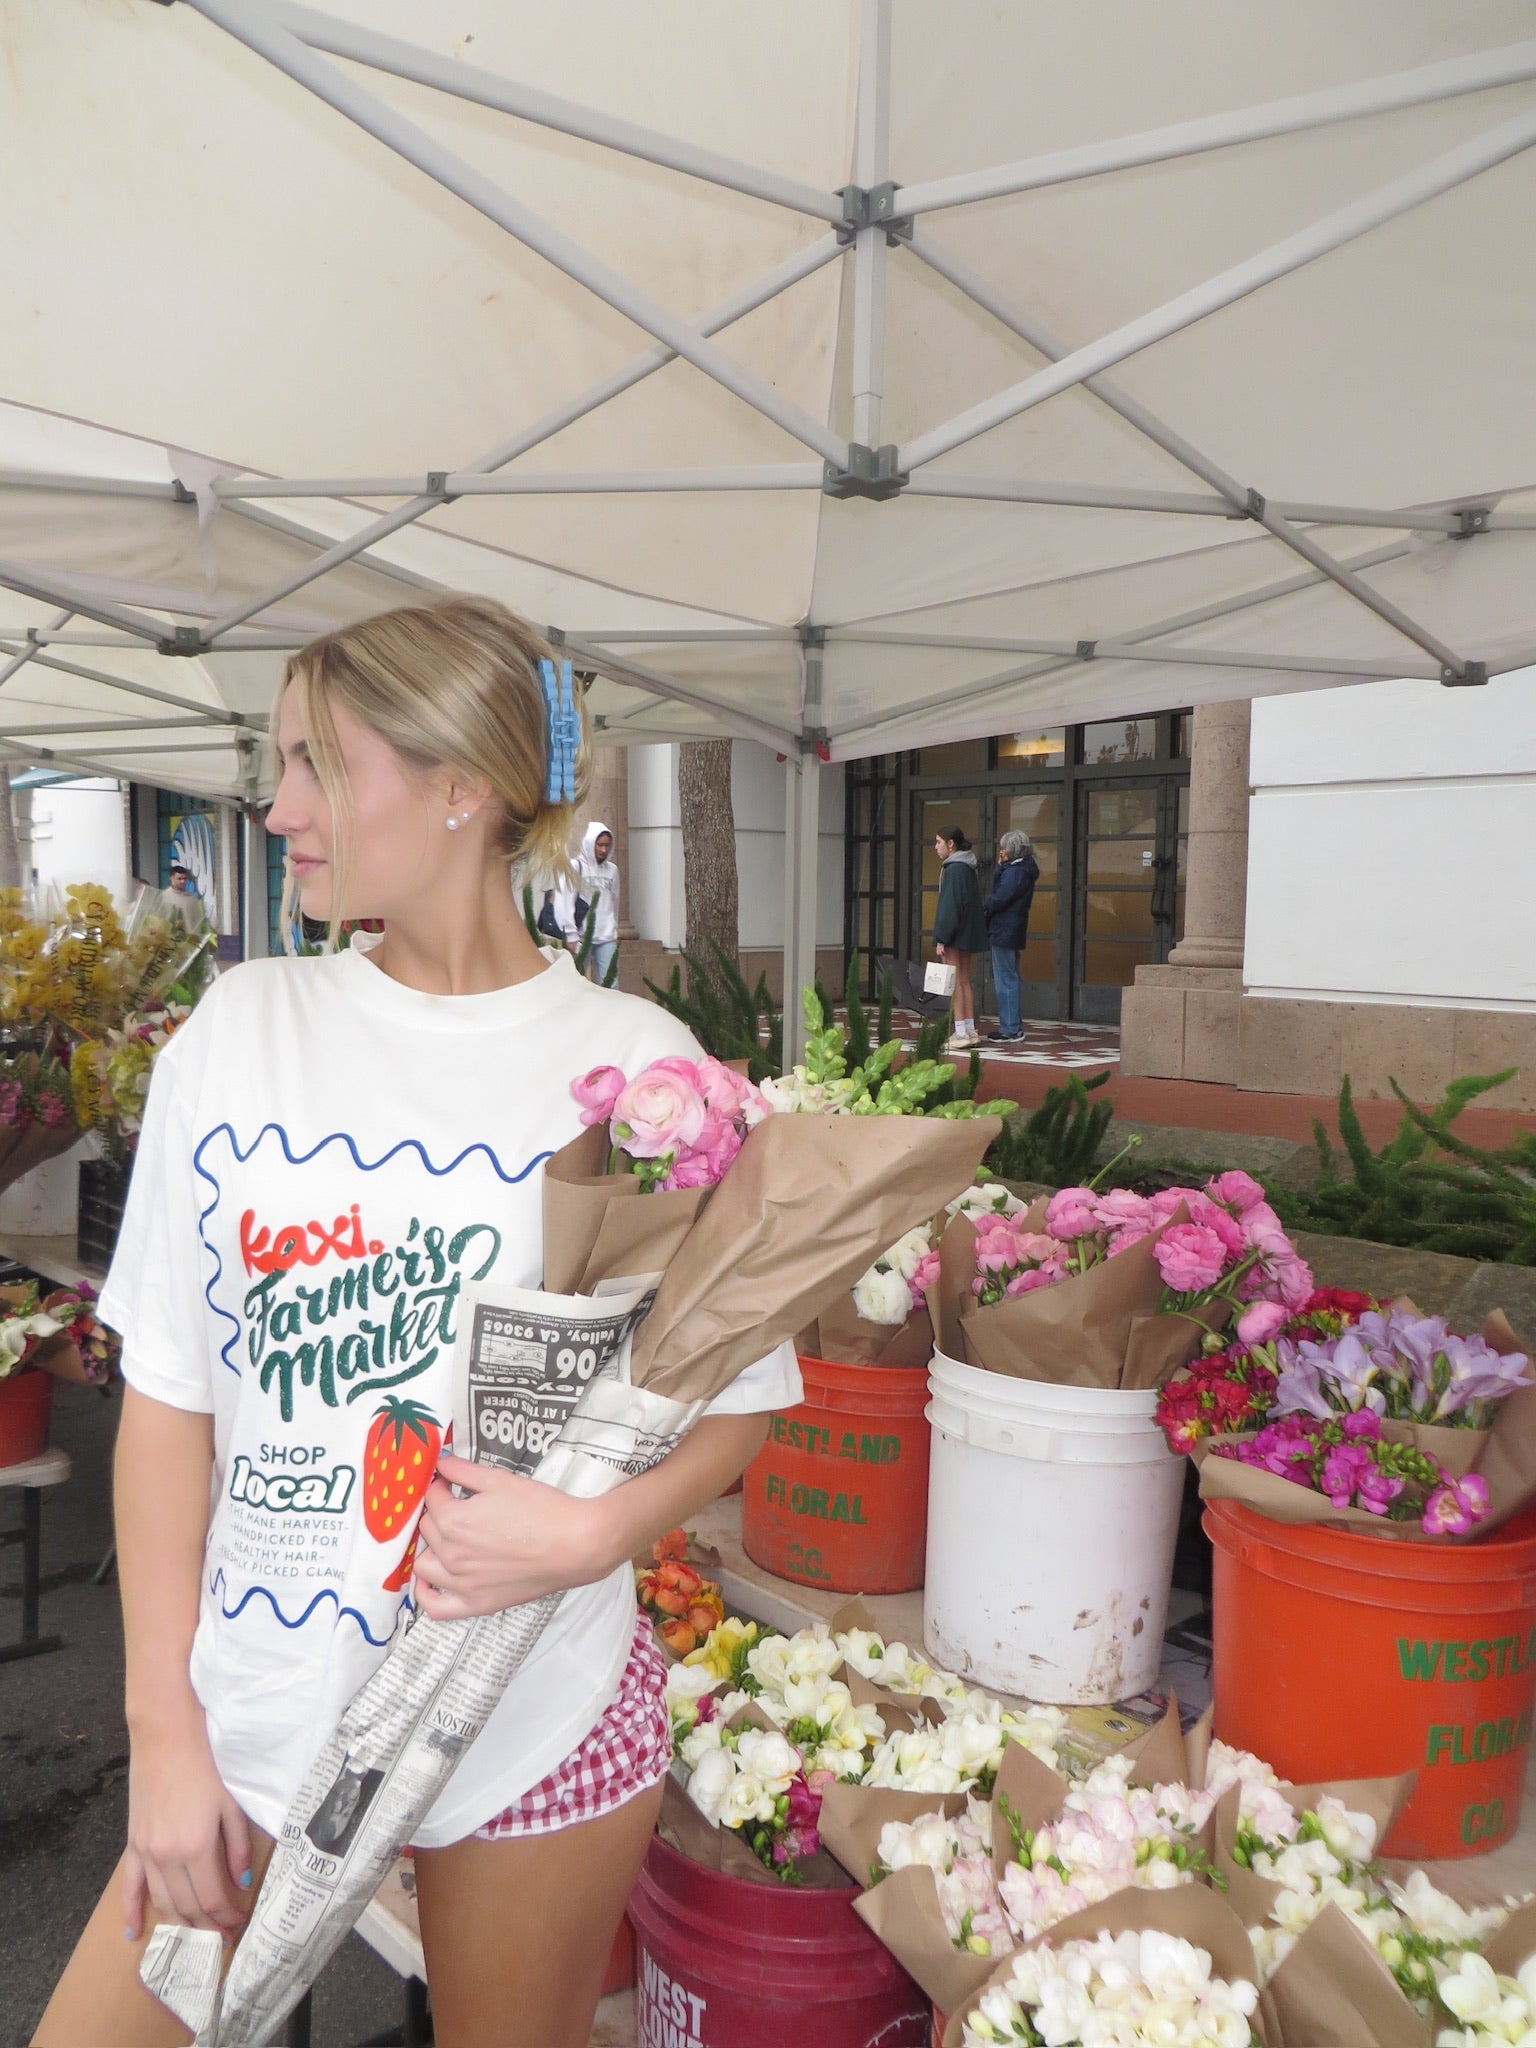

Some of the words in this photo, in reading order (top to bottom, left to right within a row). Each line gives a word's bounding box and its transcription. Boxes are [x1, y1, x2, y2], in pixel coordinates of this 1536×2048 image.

[482, 1318, 535, 1339] 93065
[540, 1328, 560, 1344] CA
[483, 1395, 518, 1410] OFFER
[541, 1406, 558, 1420] AT
[259, 1443, 326, 1465] SHOP
[229, 1454, 357, 1514] local
[246, 1511, 277, 1529] MANE
[234, 1539, 280, 1561] HEALTHY
[311, 1534, 339, 1548] FOR
[251, 1561, 300, 1578] PICKED
[1425, 1709, 1533, 1766] FLORA
[305, 1851, 337, 1877] CARL
[643, 1946, 707, 2039] WEST
